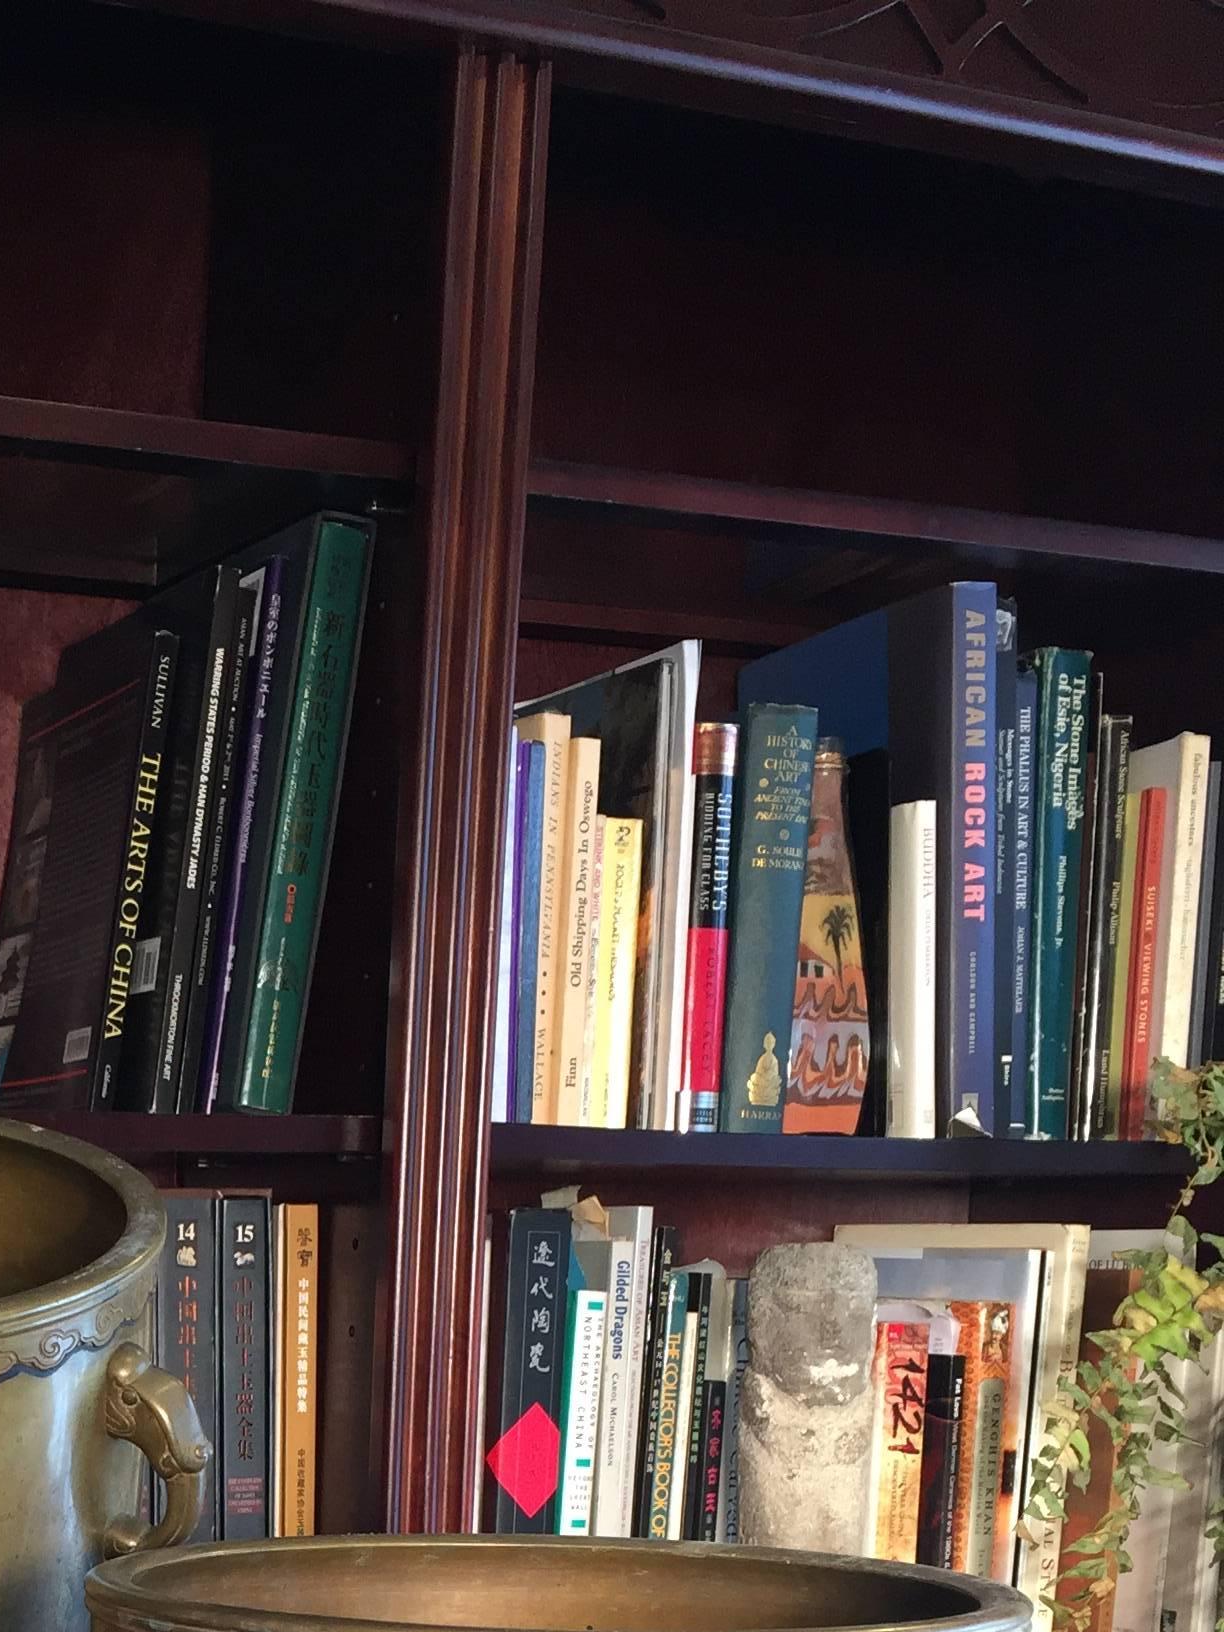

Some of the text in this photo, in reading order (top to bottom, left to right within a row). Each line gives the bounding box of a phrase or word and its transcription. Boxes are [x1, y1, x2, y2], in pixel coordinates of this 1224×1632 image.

[151, 655, 171, 728] SULLIVAN
[231, 668, 240, 701] AUCTION
[763, 758, 810, 773] CHINESE
[767, 735, 812, 750] HISTORY
[783, 748, 798, 760] OF
[787, 725, 798, 736] A
[963, 609, 987, 922] AFRICAN ROCK ART
[1049, 673, 1072, 807] of Esie, Nigeria
[1064, 675, 1086, 829] The Stone Images
[185, 647, 224, 889] WARRING STATES PERIOD & HAN DYNASTY JADES
[775, 771, 801, 782] ART
[1006, 768, 1013, 777] in
[1114, 730, 1129, 839] African Stone Sculpture
[1185, 752, 1203, 847] fabulous ancestors
[1015, 706, 1031, 910] THE PHALLUS IN ART & CULTURE
[539, 742, 562, 959] INDIANS IN PENNSYLVANIA
[569, 779, 594, 987] Old Shipping Days In Oswego
[698, 792, 716, 910] BIDDING FOR CLASS
[751, 857, 767, 868] DE
[757, 844, 769, 855] G.
[920, 827, 935, 898] BUDDHA
[104, 752, 162, 1040] THE ARTS OF CHINA
[1109, 881, 1120, 910] Philip
[1136, 885, 1156, 1042] SUISEKI VIEWING STONES
[968, 992, 976, 1008] AND
[163, 1064, 171, 1080] ART
[564, 1056, 578, 1088] Finn
[1100, 1049, 1109, 1074] Lund
[177, 1222, 196, 1241] 14
[236, 1224, 255, 1243] 15
[529, 1240, 555, 1373] 遼代陶瓷
[608, 1260, 630, 1360] Gilded Dragons
[574, 1316, 592, 1449] NORTHEAST CHINA
[586, 1317, 604, 1449] THE ARCHAEOLOGY OF
[632, 1341, 641, 1361] ART
[954, 1377, 962, 1394] Fat
[610, 1372, 619, 1403] CAROL
[888, 1357, 926, 1455] 1421
[952, 1396, 960, 1418] Lava
[650, 1332, 681, 1537] THE COLLECTOR'S BOOK OF
[981, 1392, 1002, 1536] GENGHIS KHAN
